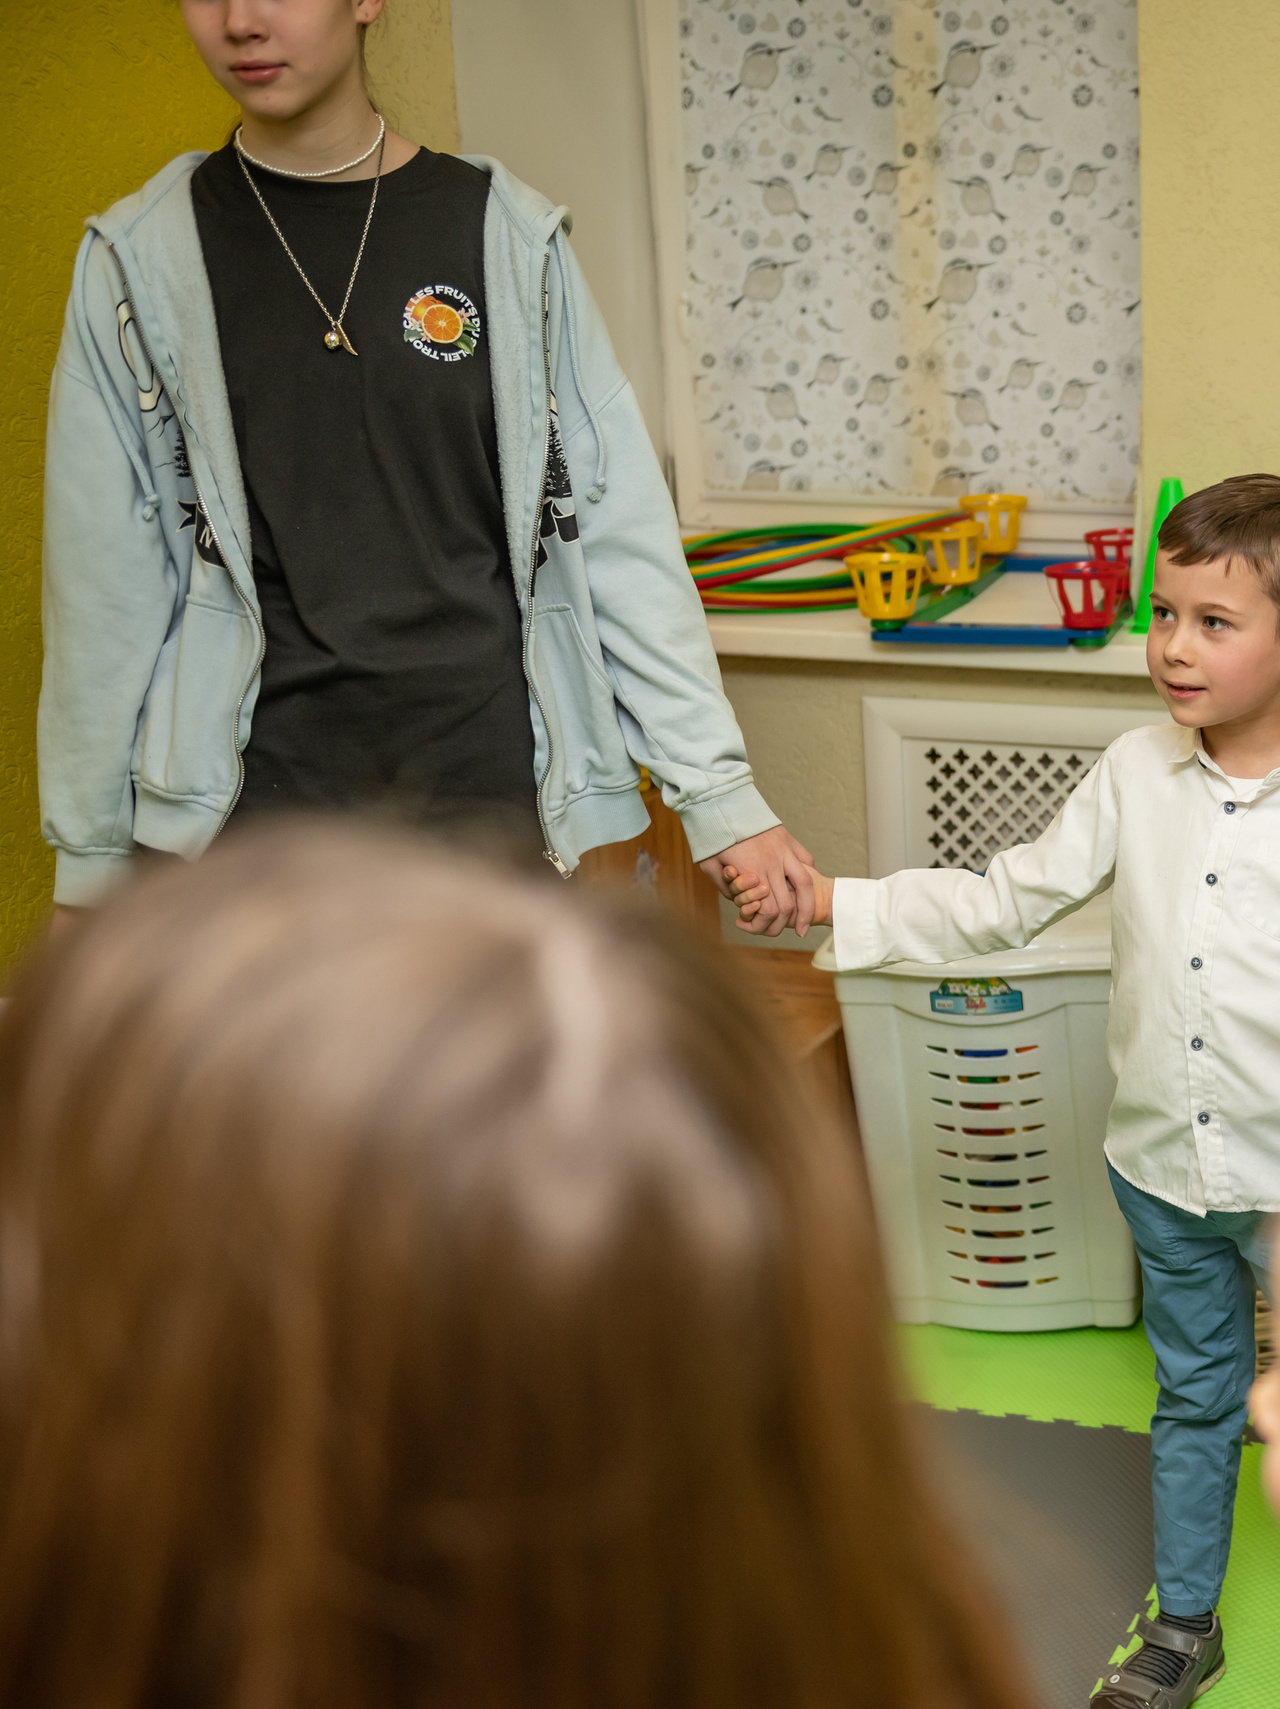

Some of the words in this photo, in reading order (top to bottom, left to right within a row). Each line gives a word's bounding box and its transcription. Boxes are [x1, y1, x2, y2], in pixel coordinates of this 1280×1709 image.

[409, 286, 434, 305] LES
[435, 285, 478, 316] FRUITS
[471, 317, 481, 338] DU
[440, 337, 478, 362] SLEIL
